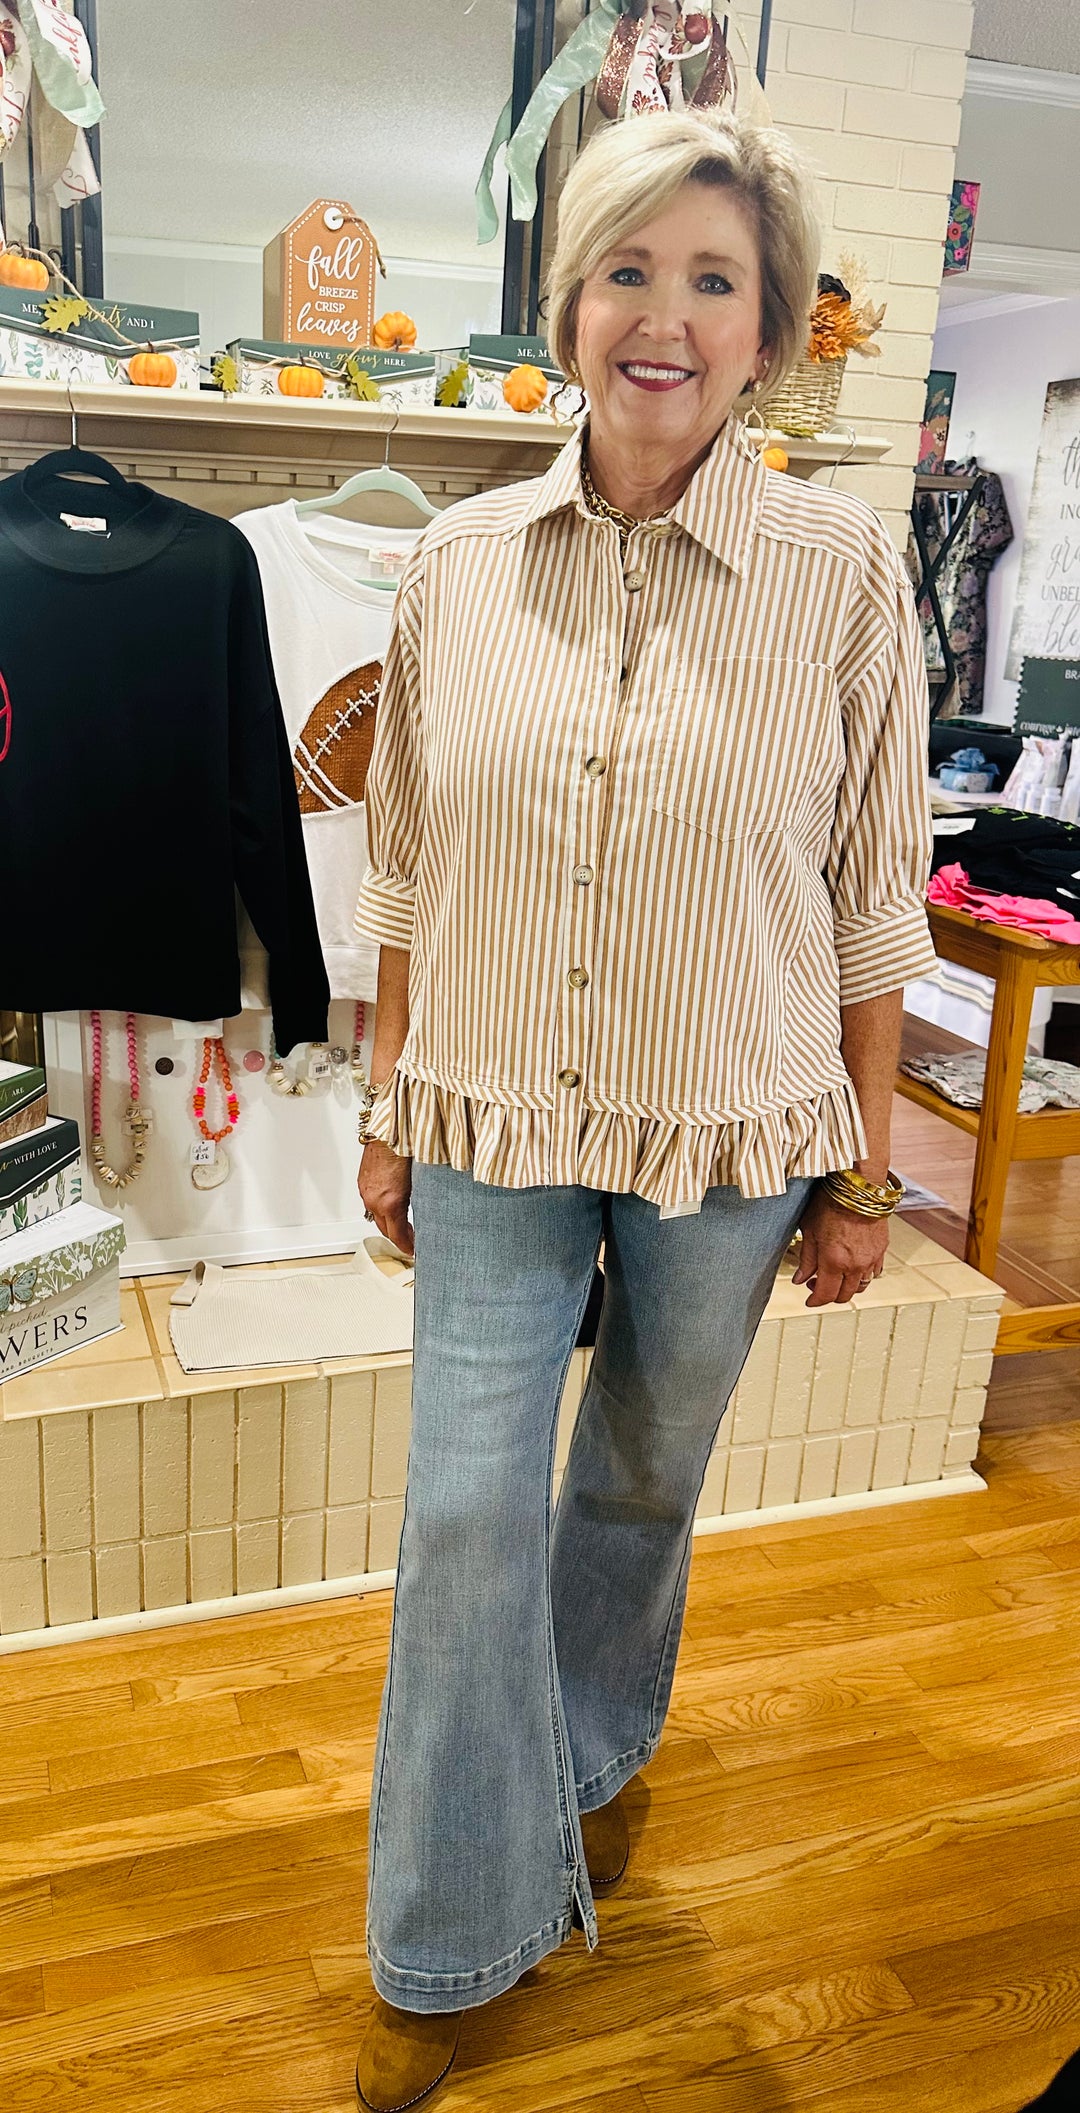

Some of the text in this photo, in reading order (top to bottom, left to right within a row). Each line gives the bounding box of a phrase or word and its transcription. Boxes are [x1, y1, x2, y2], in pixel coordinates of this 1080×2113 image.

[294, 236, 363, 290] fall
[318, 285, 359, 300] BREEZE
[314, 300, 346, 313] CRISP
[126, 317, 148, 328] AND
[149, 320, 155, 329] I
[296, 301, 362, 342] leaves
[308, 349, 331, 360] LOVE
[383, 357, 406, 367] HERE
[517, 348, 552, 358] ME, M
[11, 1086, 25, 1097] ARE
[13, 1141, 58, 1166] WITH LOVE
